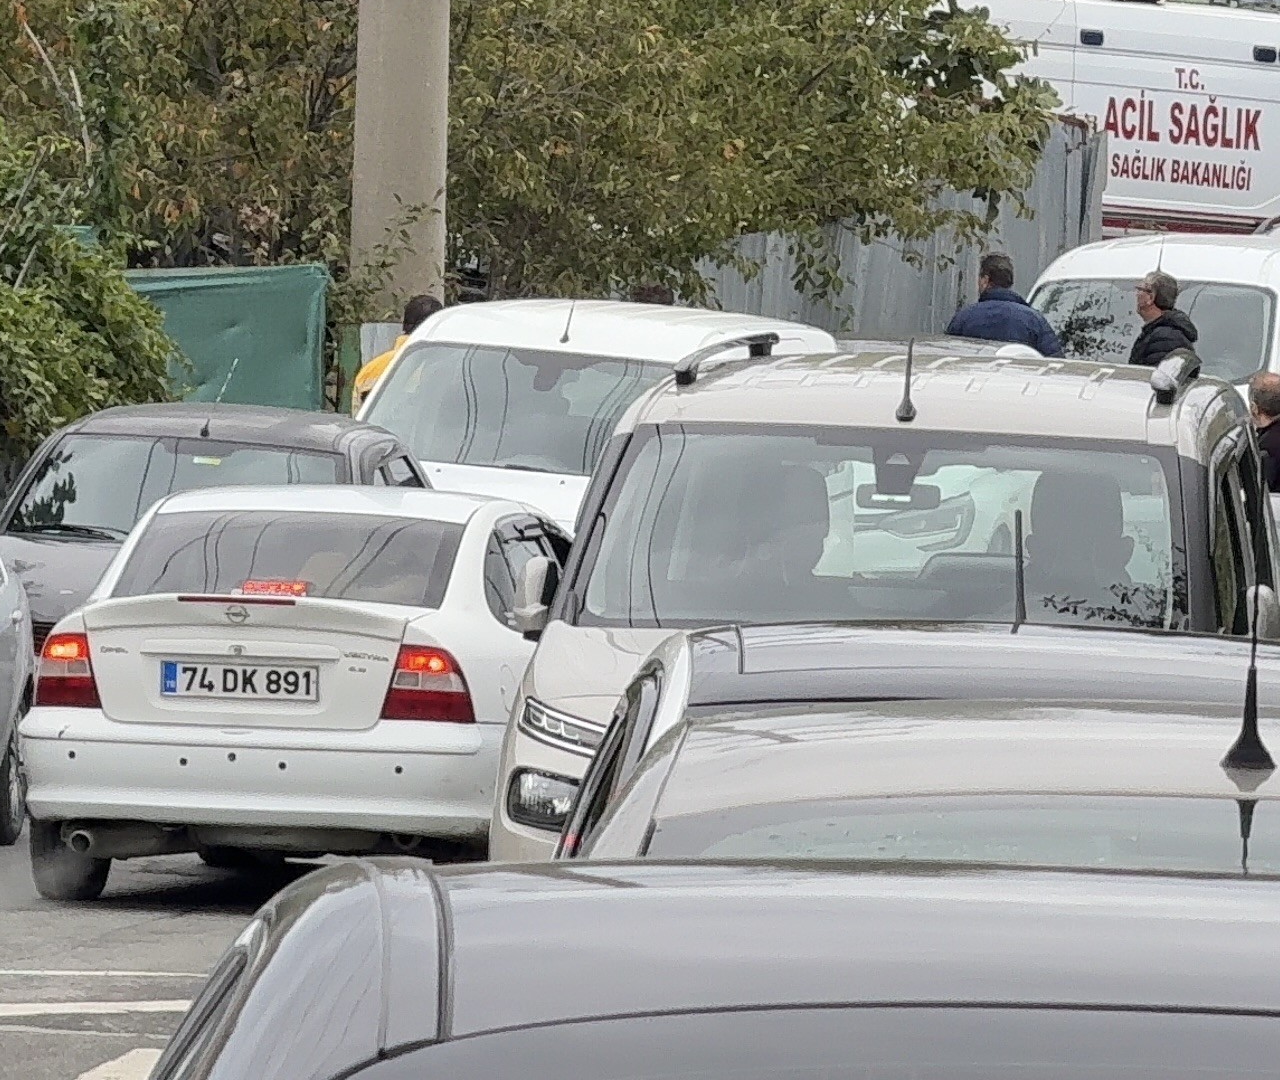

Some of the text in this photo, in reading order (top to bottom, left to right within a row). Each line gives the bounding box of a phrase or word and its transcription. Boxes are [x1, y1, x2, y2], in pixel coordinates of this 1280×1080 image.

[1175, 67, 1205, 90] T.C.
[1104, 89, 1262, 151] ACİL SAĞLIK
[1110, 148, 1252, 191] SAĞLIK BAKANLIĞI
[182, 666, 311, 696] 74 DK 891
